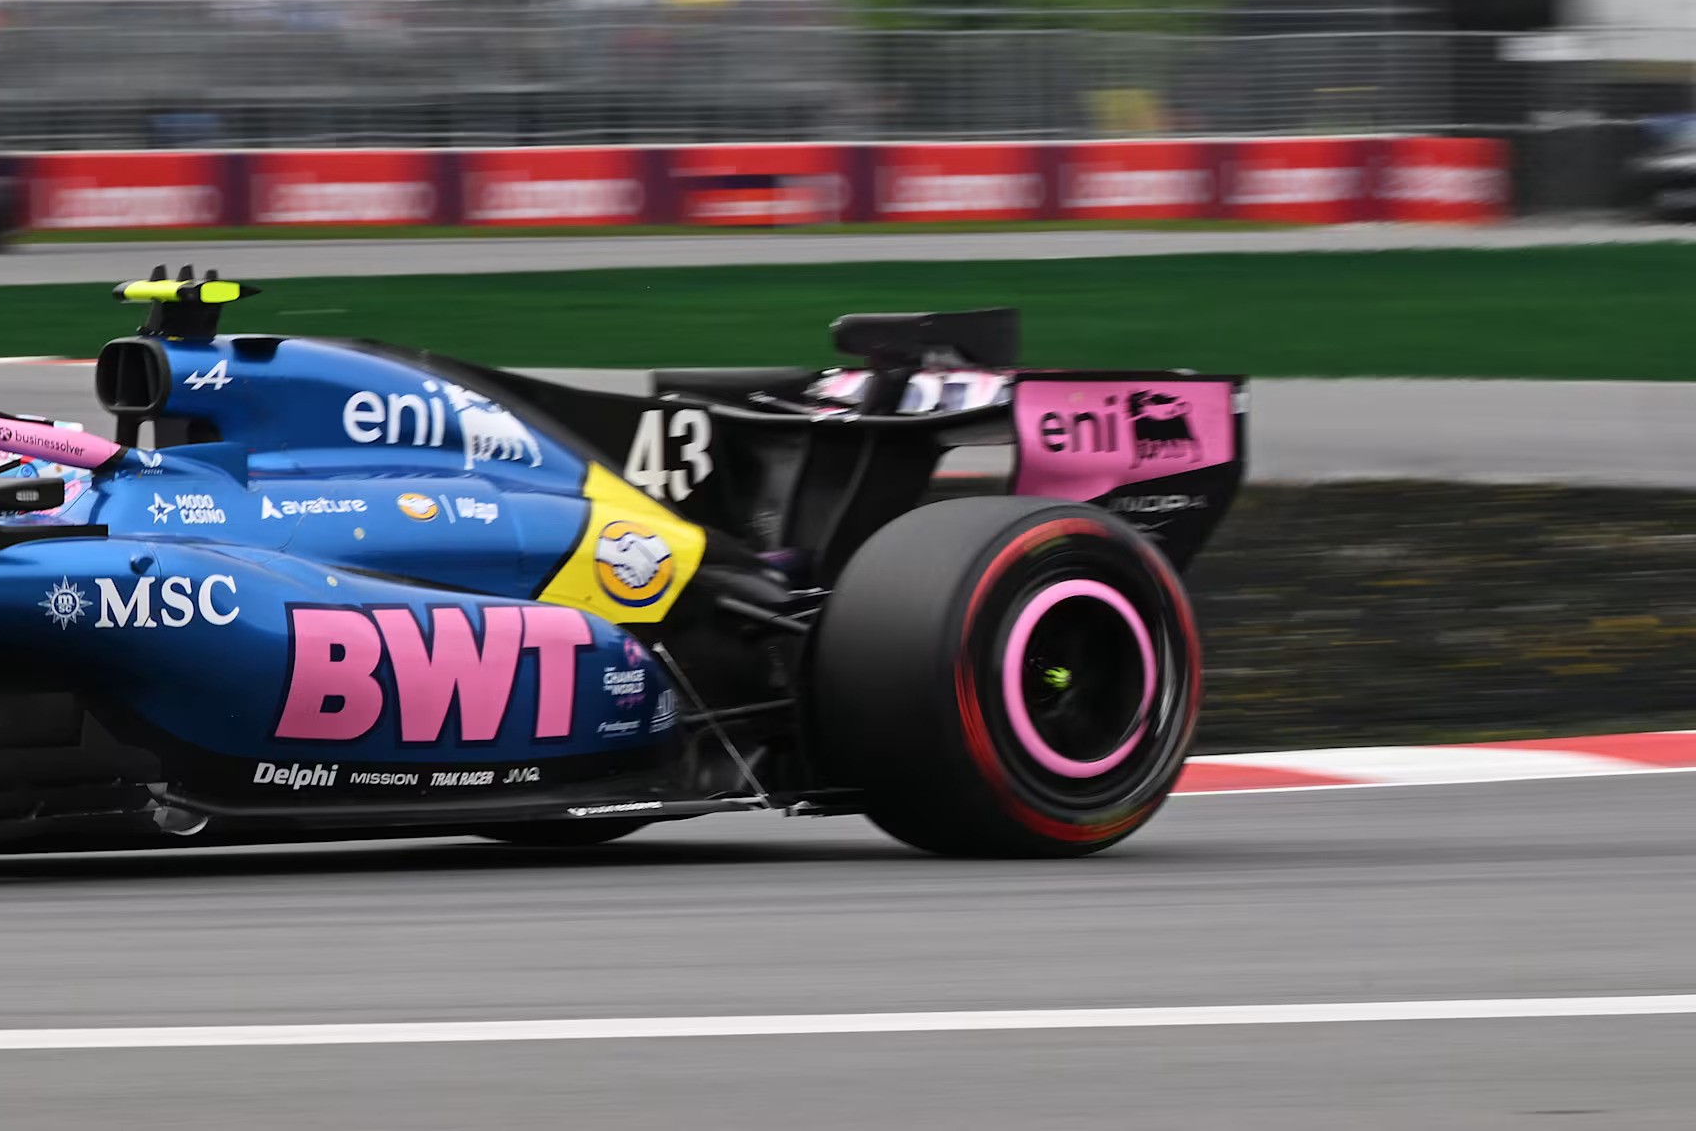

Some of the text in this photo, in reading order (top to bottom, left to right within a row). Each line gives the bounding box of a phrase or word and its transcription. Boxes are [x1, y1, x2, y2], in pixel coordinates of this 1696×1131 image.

[343, 380, 445, 447] eni
[1039, 394, 1119, 453] eni
[15, 431, 85, 457] businessolver
[623, 408, 714, 502] 43
[175, 494, 215, 510] MODO
[180, 508, 226, 524] CASINO
[280, 496, 368, 516] avature
[94, 574, 240, 629] MSC
[273, 605, 594, 743] BWT
[253, 761, 339, 790] Delphi
[349, 772, 420, 786] MISSION
[429, 772, 458, 787] TRAK
[458, 771, 496, 786] RACER
